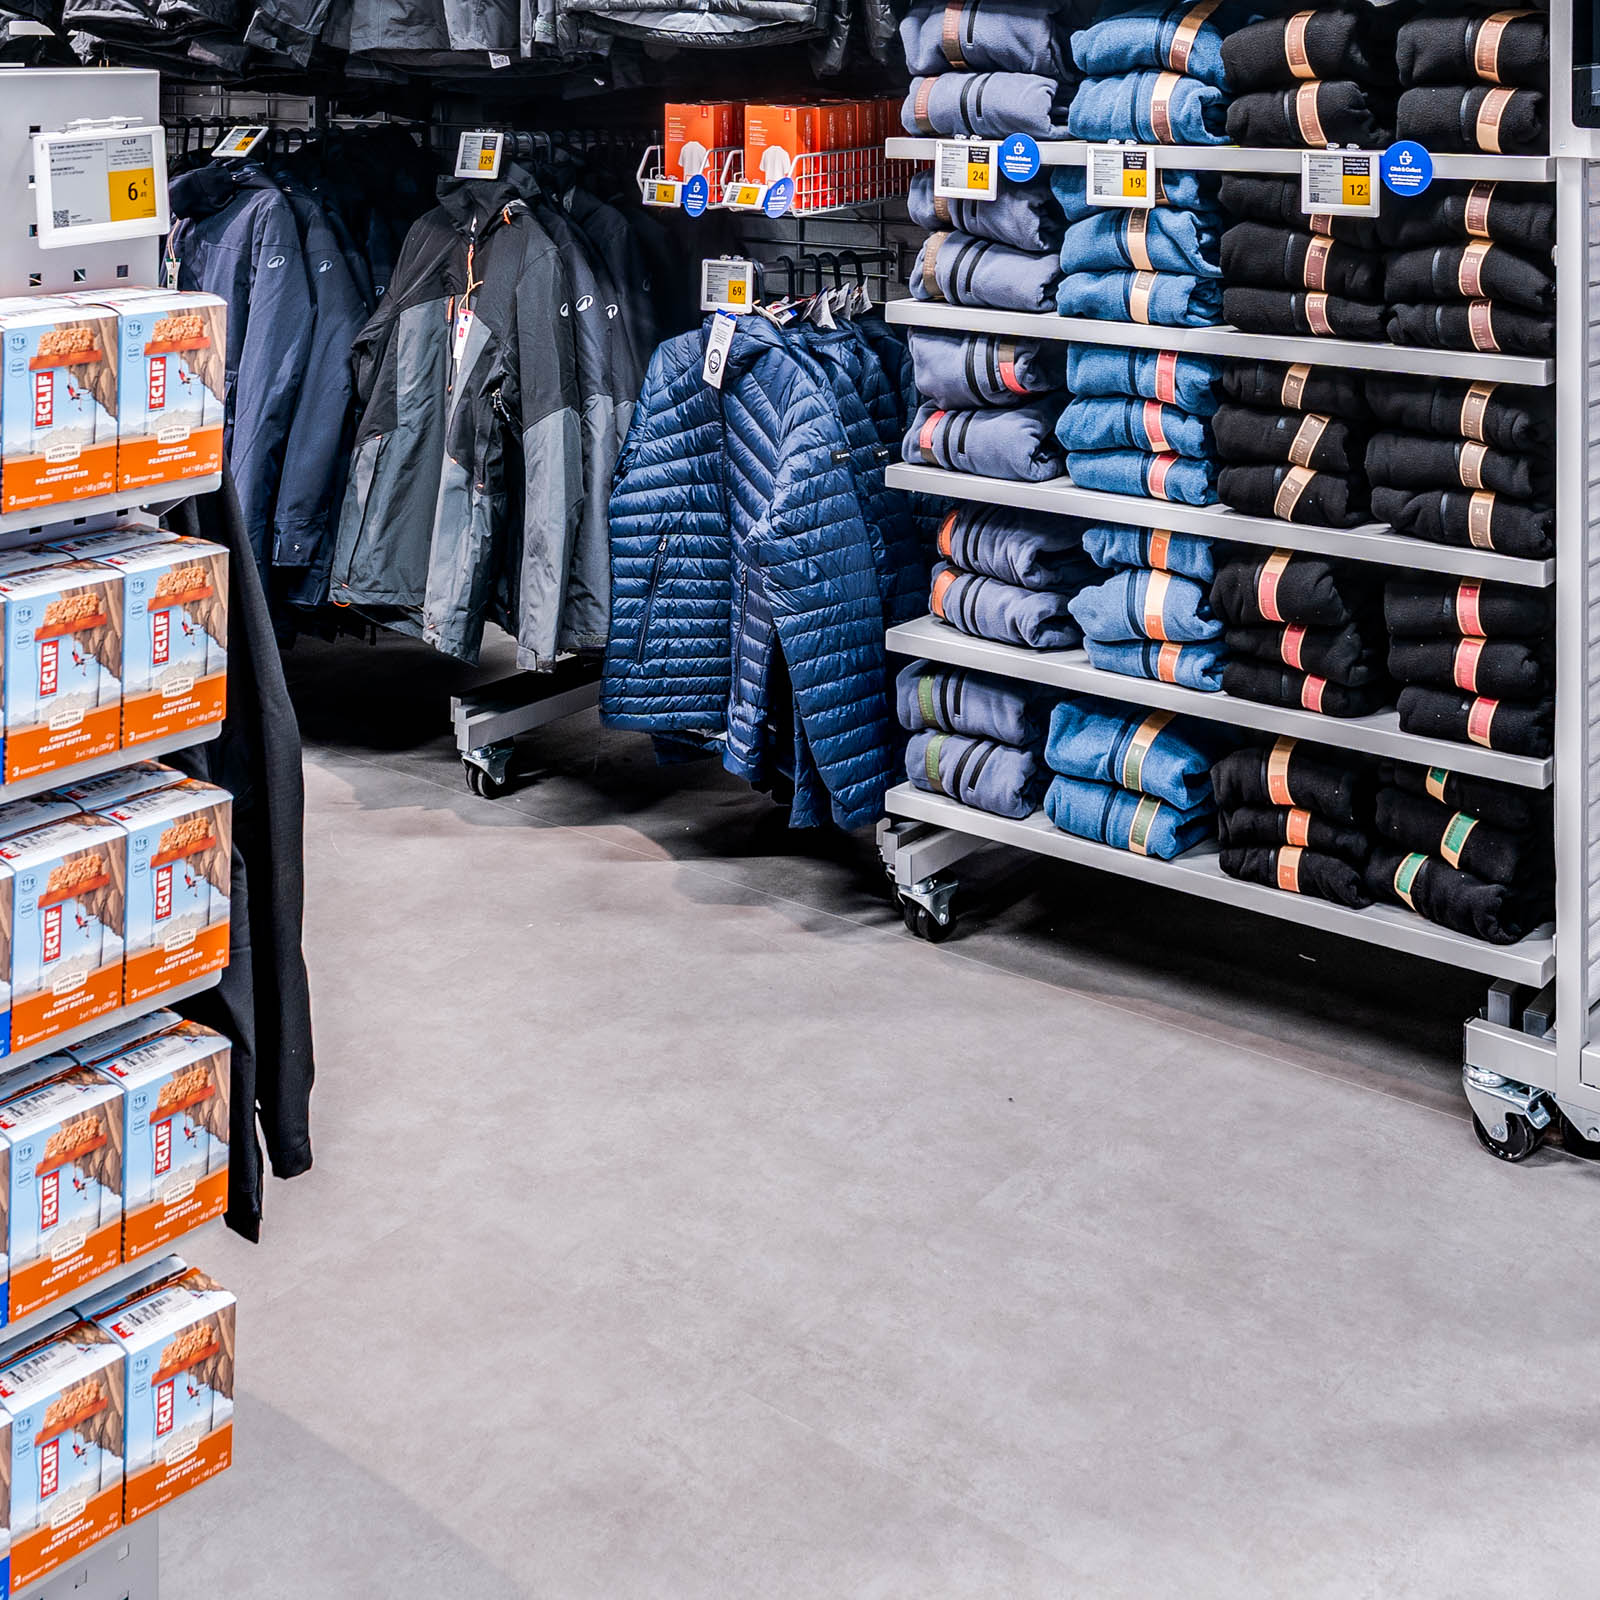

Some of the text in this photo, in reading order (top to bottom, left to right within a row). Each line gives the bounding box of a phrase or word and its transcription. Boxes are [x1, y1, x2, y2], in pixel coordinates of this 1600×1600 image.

[128, 182, 138, 201] 6
[973, 170, 984, 182] 24
[1130, 177, 1141, 189] 19
[1349, 184, 1363, 196] 12
[732, 286, 742, 296] 69
[36, 375, 52, 413] CLIF
[150, 361, 165, 397] CLIF
[148, 451, 197, 464] PEANUT BUTTER
[157, 446, 188, 456] CRUNCHY
[35, 470, 88, 485] PEANUT BUTTER
[46, 464, 79, 476] CRUNCHY
[154, 615, 168, 650] CLIF
[42, 645, 57, 681] CLIF
[157, 868, 171, 906] CLIF
[45, 909, 61, 948] CLIF
[156, 1124, 170, 1159] CLIF
[43, 1177, 58, 1213] CLIF
[156, 1384, 173, 1422] CLIF
[41, 1443, 57, 1481] CLIF
